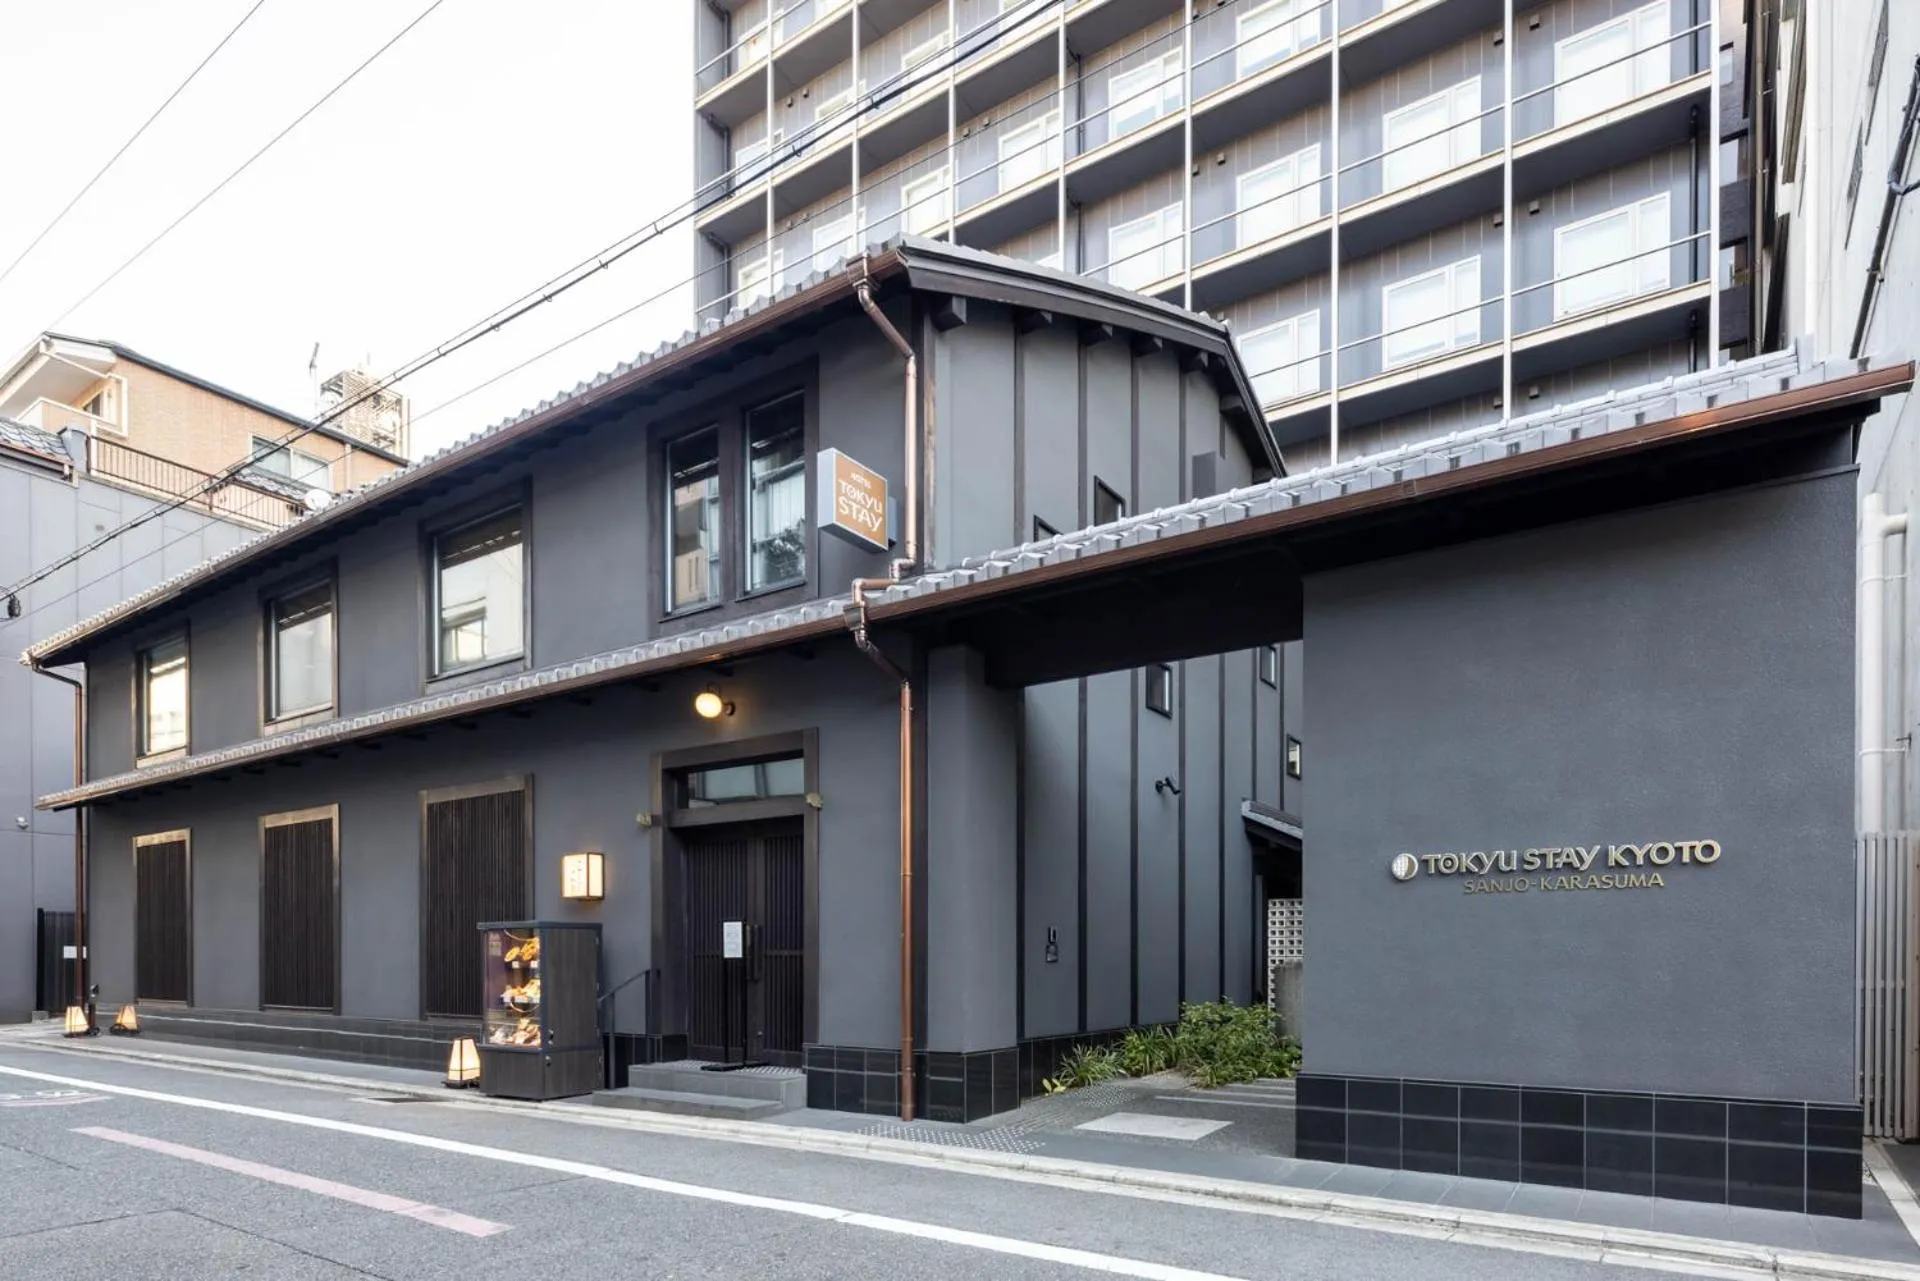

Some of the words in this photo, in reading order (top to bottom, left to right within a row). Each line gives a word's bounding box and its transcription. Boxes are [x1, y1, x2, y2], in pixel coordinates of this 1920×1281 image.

[838, 479, 882, 514] TOKYU
[838, 496, 883, 532] STAY
[1421, 850, 1517, 875] TOKYU
[1523, 844, 1600, 871] STAY
[1608, 839, 1721, 867] KYOTO
[1464, 872, 1665, 894] SANJO-KARASUMA
